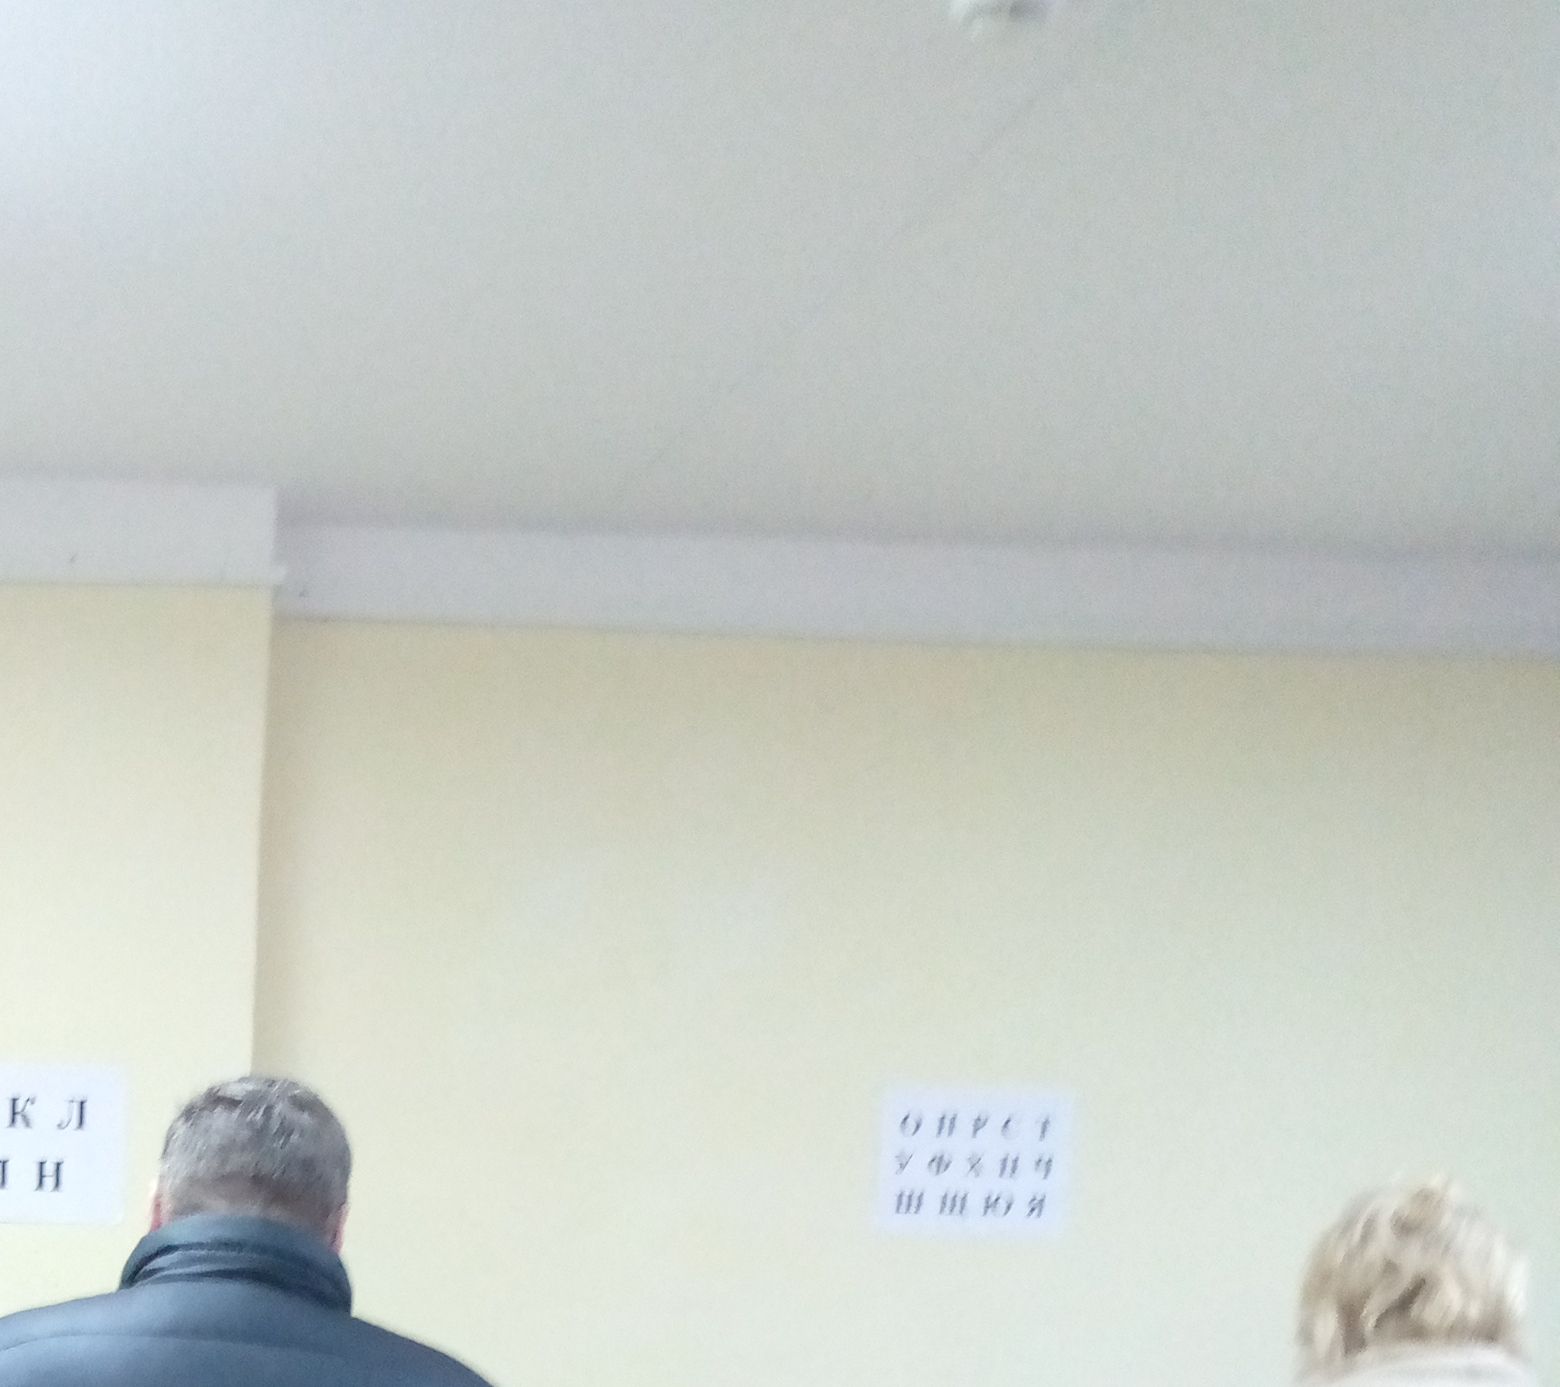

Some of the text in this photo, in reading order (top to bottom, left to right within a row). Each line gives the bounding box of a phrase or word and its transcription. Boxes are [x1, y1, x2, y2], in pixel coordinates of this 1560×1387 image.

[7, 1096, 36, 1128] К
[56, 1099, 87, 1130] Л
[35, 1159, 64, 1192] Н
